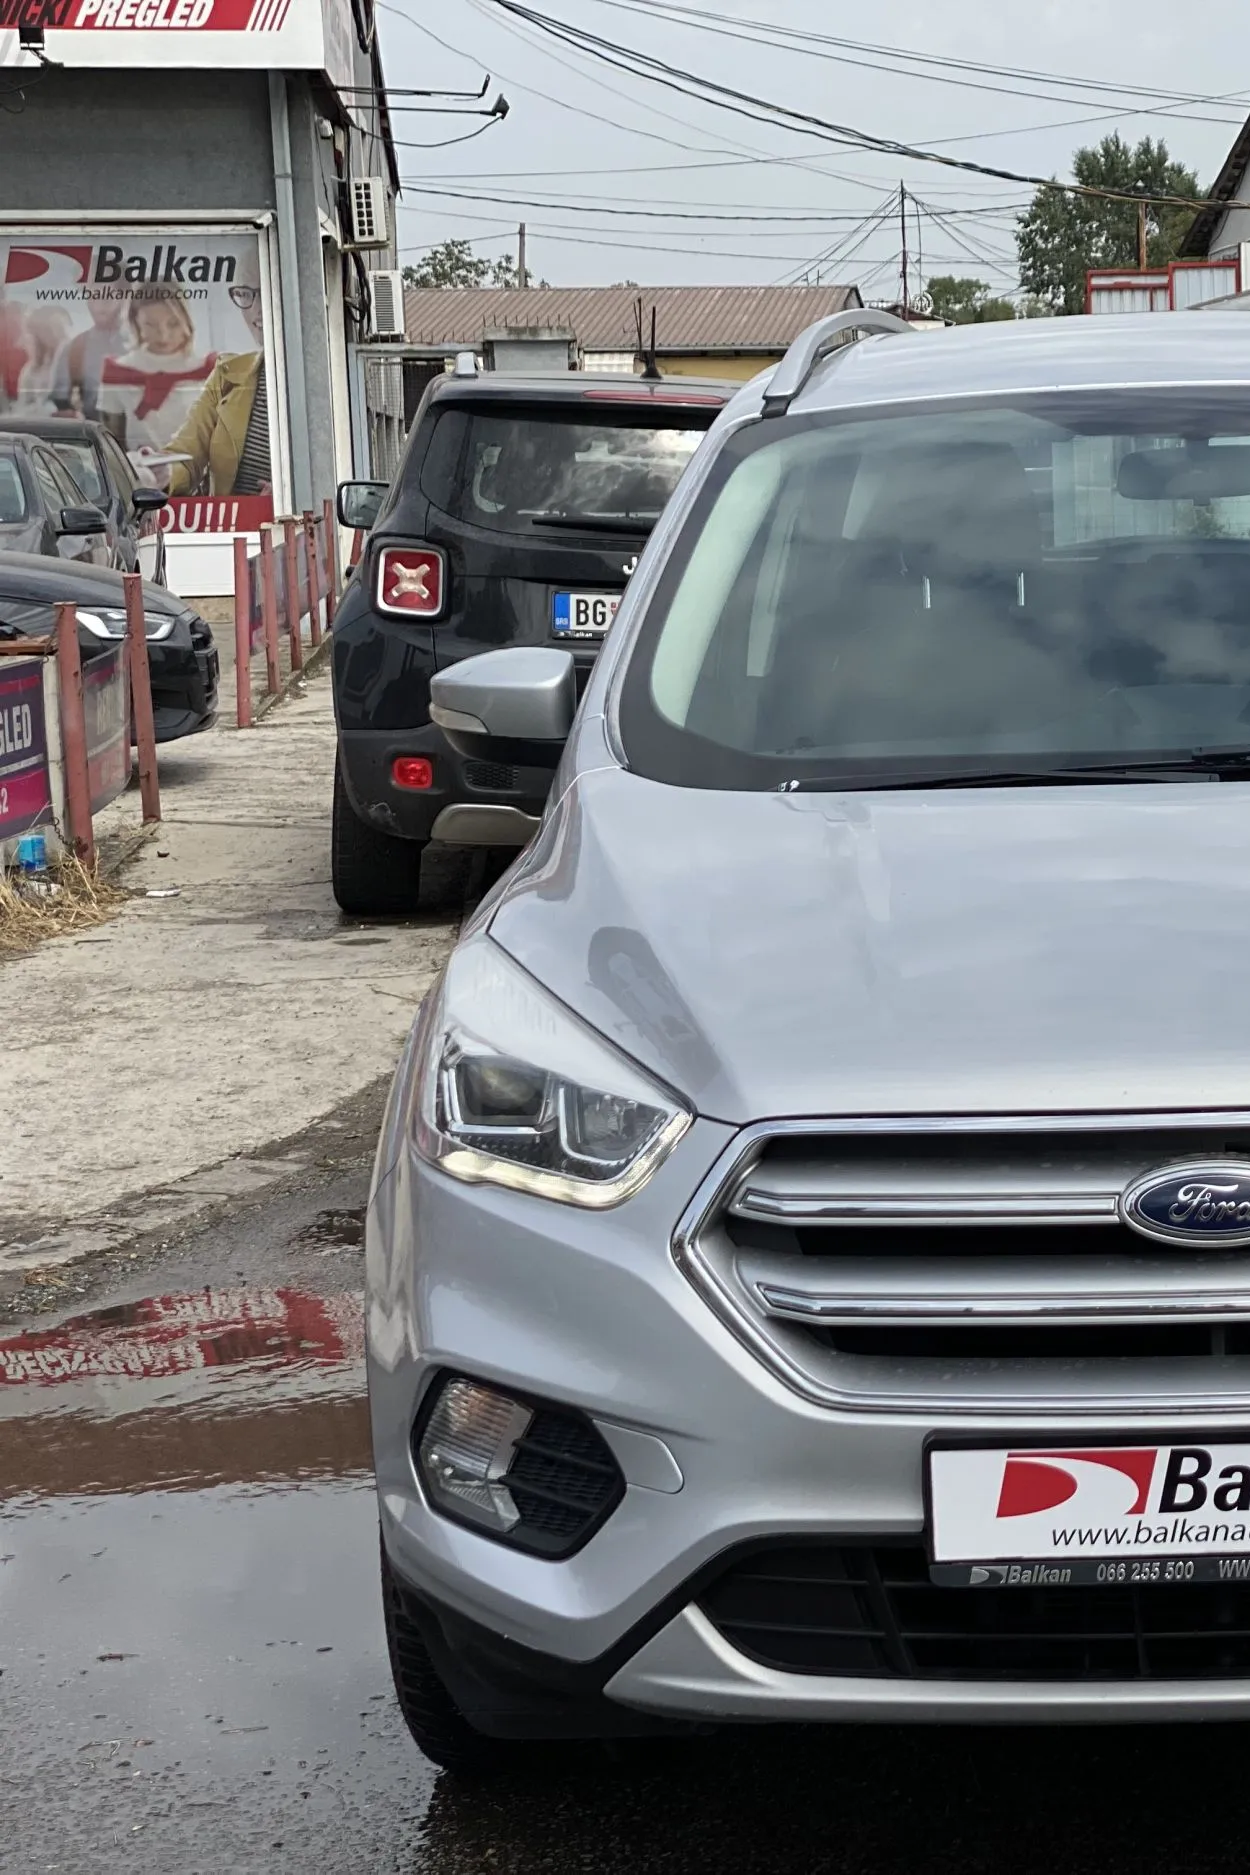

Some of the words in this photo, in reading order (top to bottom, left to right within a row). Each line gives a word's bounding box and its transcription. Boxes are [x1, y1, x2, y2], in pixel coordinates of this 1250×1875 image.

[74, 0, 214, 27] PREGLED
[94, 245, 237, 283] Balkan
[36, 286, 208, 300] www.balkanauto.com
[576, 598, 606, 626] BG
[1005, 1565, 1072, 1584] Balkan
[1097, 1563, 1126, 1581] 066
[1131, 1562, 1160, 1581] 255
[1164, 1561, 1195, 1580] 500
